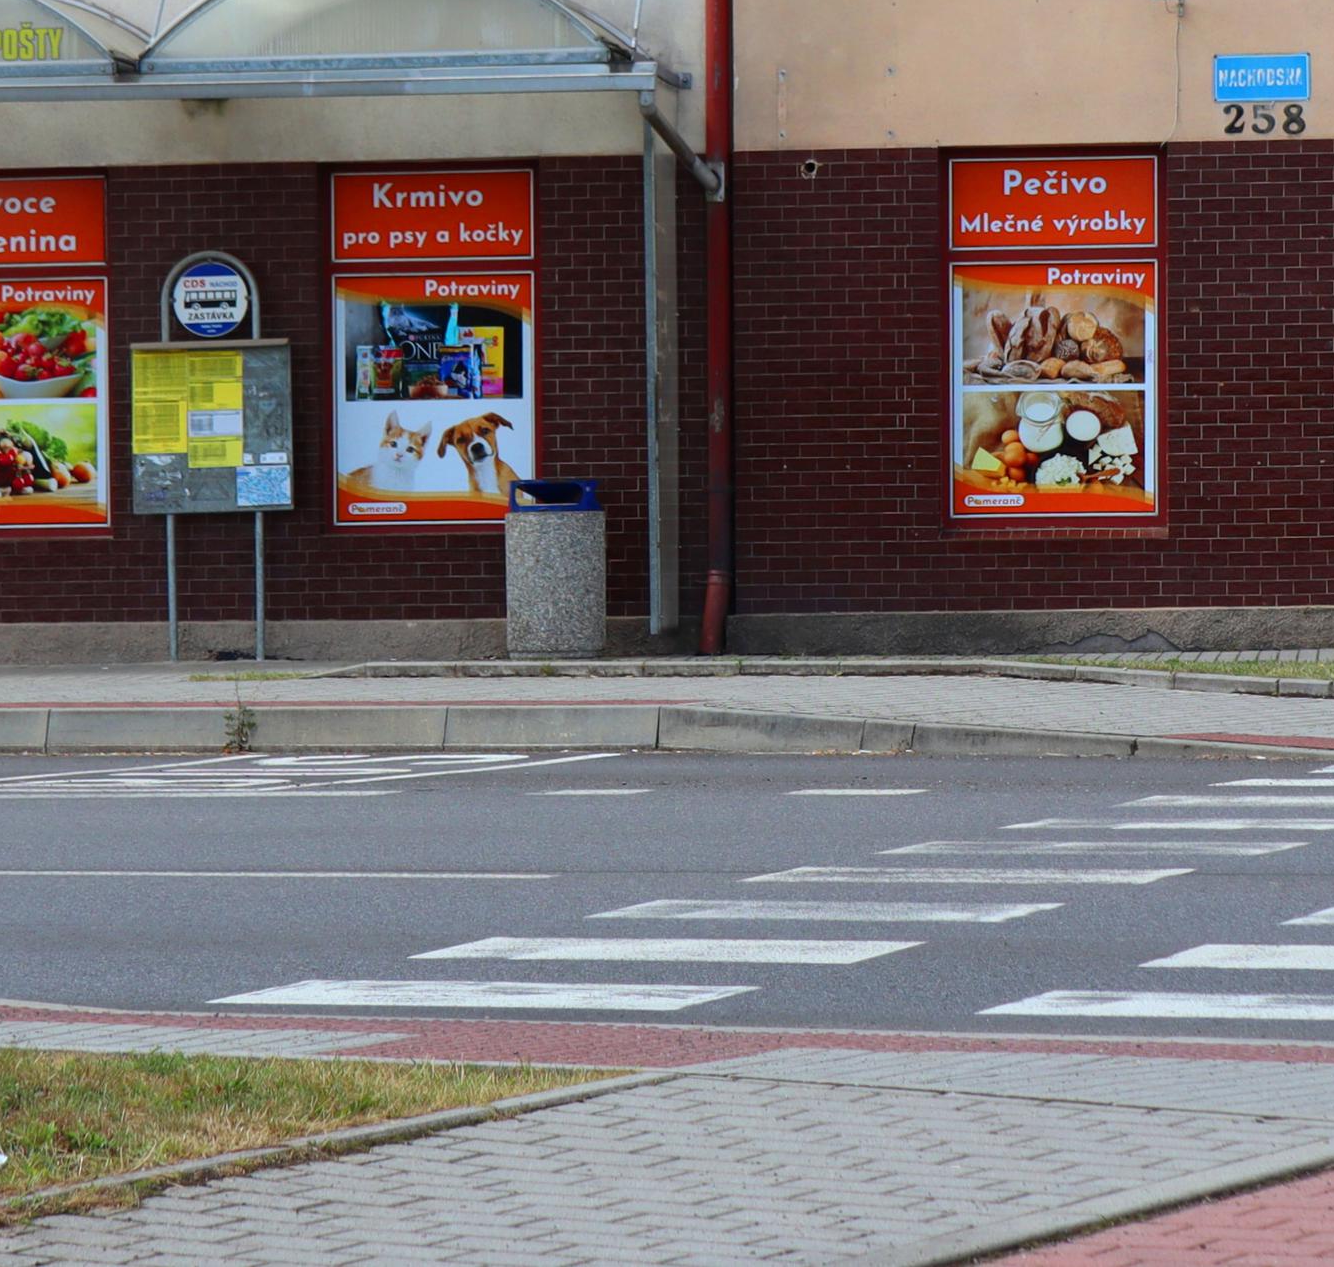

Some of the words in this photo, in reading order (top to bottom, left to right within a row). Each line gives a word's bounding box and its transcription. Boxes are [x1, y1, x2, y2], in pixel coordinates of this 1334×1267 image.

[1223, 103, 1307, 135] 258
[1002, 169, 1108, 197] Pečivo
[371, 182, 484, 209] Krmivo
[960, 213, 1044, 235] Mlečné
[1052, 210, 1147, 237] výrobky
[342, 231, 380, 250] pro
[389, 230, 427, 249] psy
[435, 229, 450, 244] a
[458, 223, 524, 247] kočky
[183, 279, 206, 289] CDS
[424, 280, 520, 299] Potraviny
[1047, 268, 1146, 289] Potraviny
[0, 285, 95, 305] Potraviny
[187, 312, 235, 321] ZASTÁVKA
